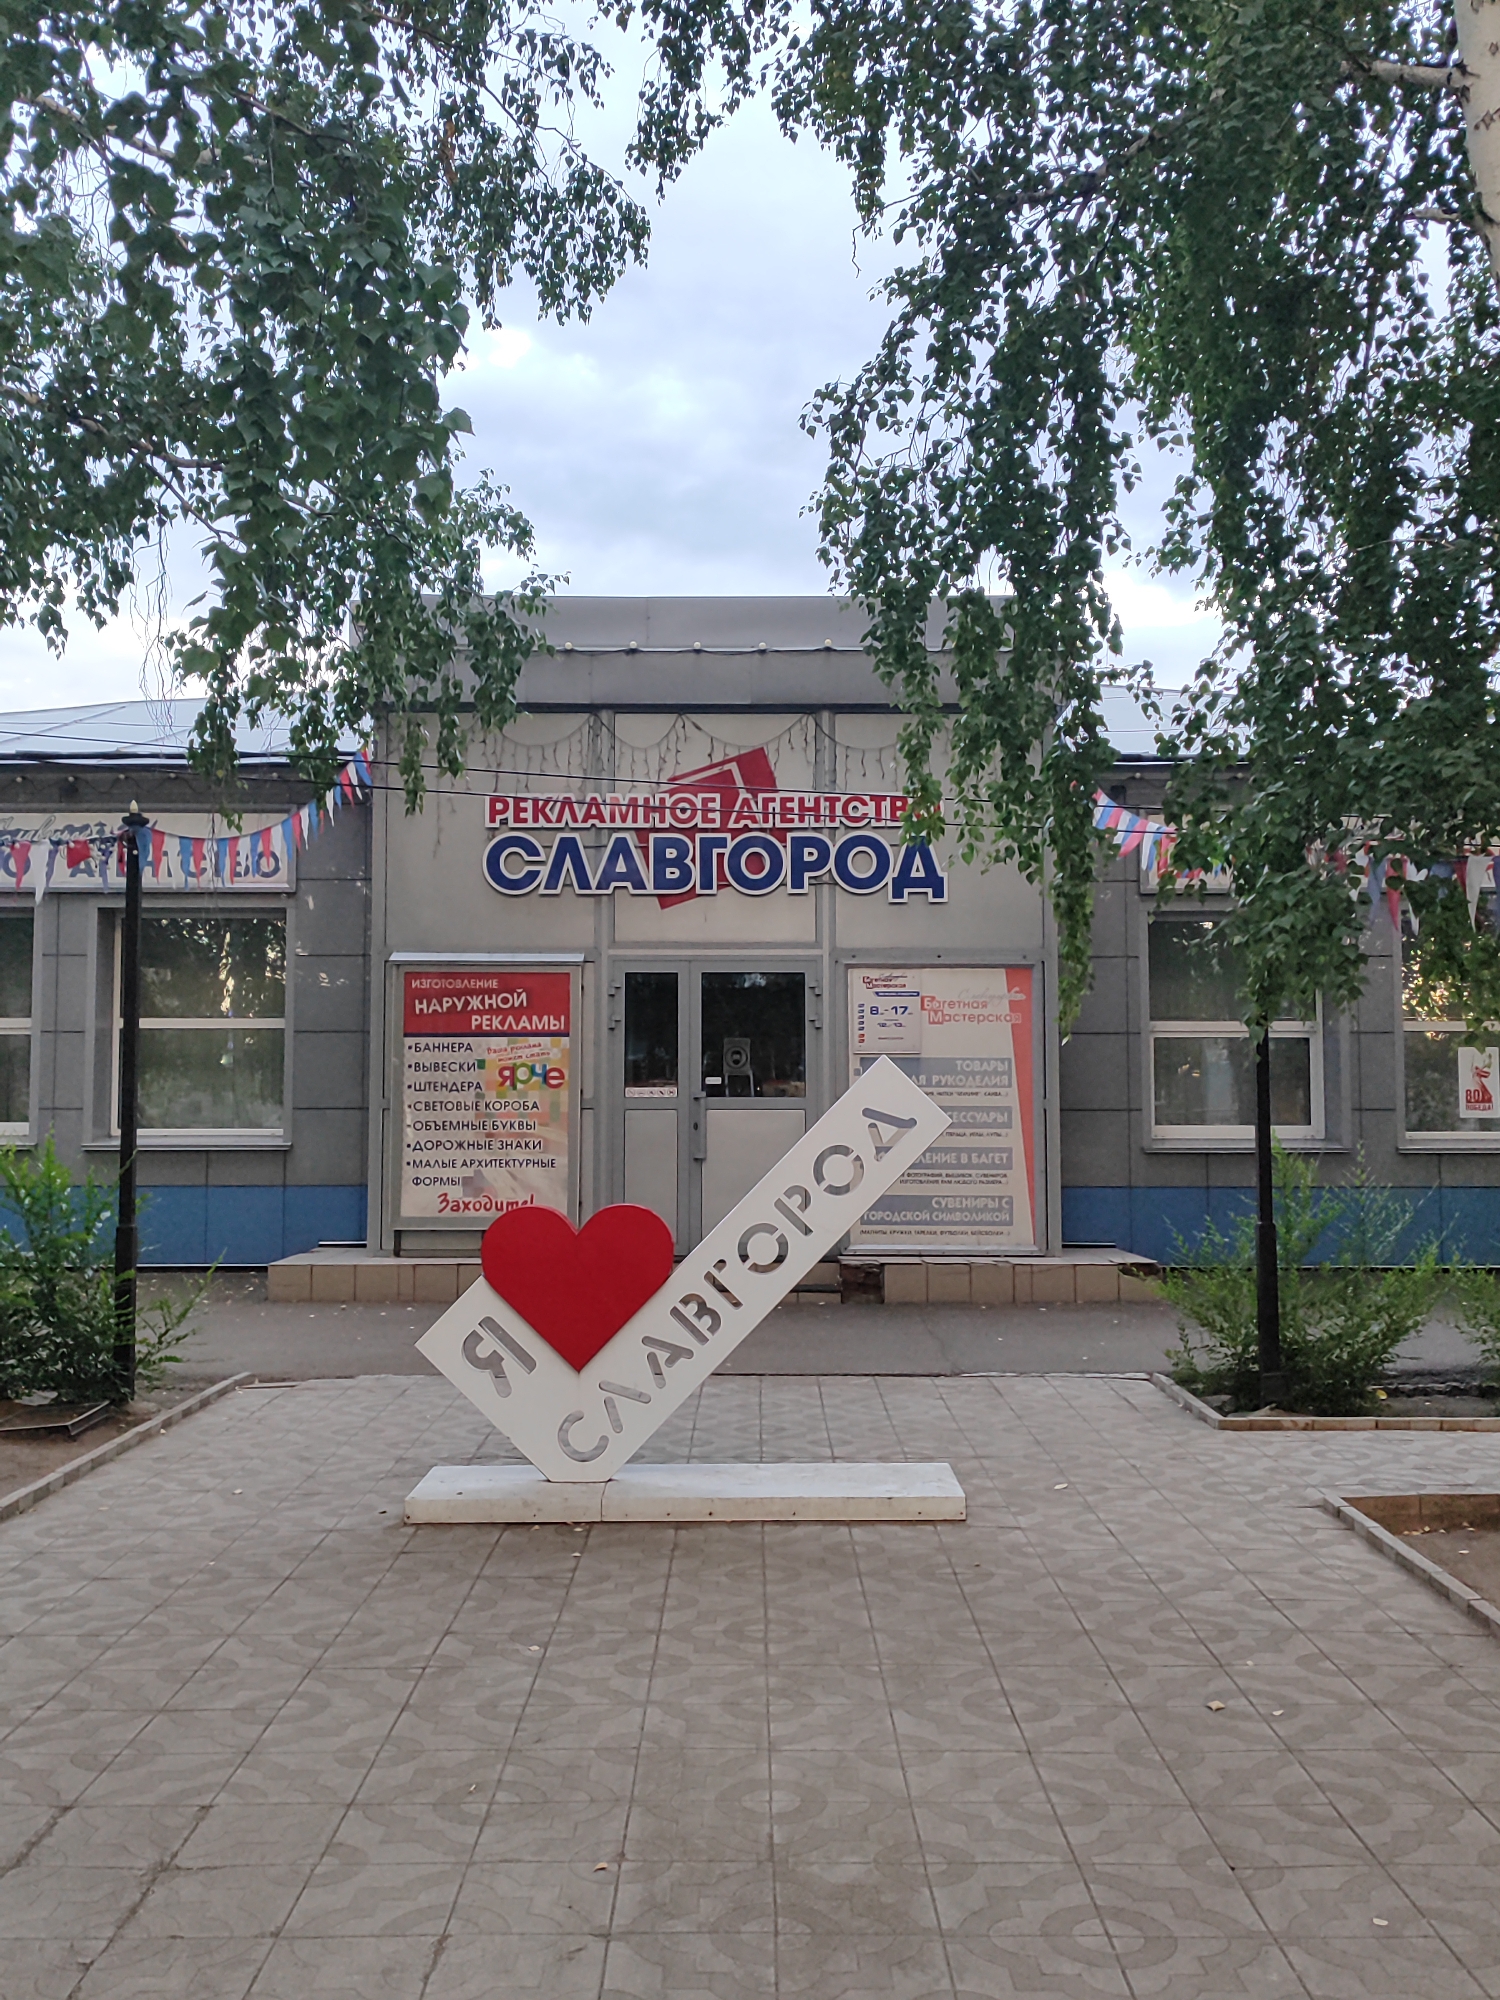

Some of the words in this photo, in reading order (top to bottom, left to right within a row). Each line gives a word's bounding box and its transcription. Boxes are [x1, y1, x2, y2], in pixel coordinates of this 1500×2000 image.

[487, 794, 721, 827] РЕКЛАМНОЕ
[730, 794, 943, 827] АГЕНТСТВ
[483, 833, 948, 902] СЛАВГОРОД
[411, 979, 499, 989] ИЗГОТОВЛЕНИЕ
[414, 988, 527, 1015] НАРУЖНОЙ
[471, 1015, 565, 1030] РЕКЛАМЫ
[929, 1011, 1021, 1025] Мастерская
[414, 1042, 474, 1053] БАННЕРА
[413, 1061, 476, 1073] ВЫВЕСКИ
[955, 1060, 1009, 1072] ТОВАРЫ
[932, 1074, 1009, 1087] РУКОДЕЛИЯ
[413, 1081, 483, 1093] ШТЕНДЕРА
[413, 1100, 481, 1111] СВЕТОВЫЕ
[484, 1100, 540, 1111] КОРОБА
[413, 1120, 488, 1131] ОБЪЕМНЫЕ
[491, 1120, 536, 1131] БУКВЫ
[412, 1140, 494, 1152] ДОРОЖНЫЕ
[497, 1139, 542, 1150] ЗНАКИ
[412, 1159, 457, 1169] МАЛЫЕ
[460, 1158, 556, 1169] АРХИТЕКТУРНЫЕ
[971, 1152, 1009, 1164] БАГЕТ
[412, 1176, 461, 1187] ФОРМЫ
[931, 1197, 999, 1208] СУВЕНИРЫ
[1002, 1197, 1010, 1208] С
[863, 1209, 930, 1222] ГОРОДСКОЙ
[931, 1209, 1010, 1222] СИМВОЛИКОЙ
[556, 1106, 918, 1463] СЛАВГОРОД
[461, 1316, 537, 1398] Я
